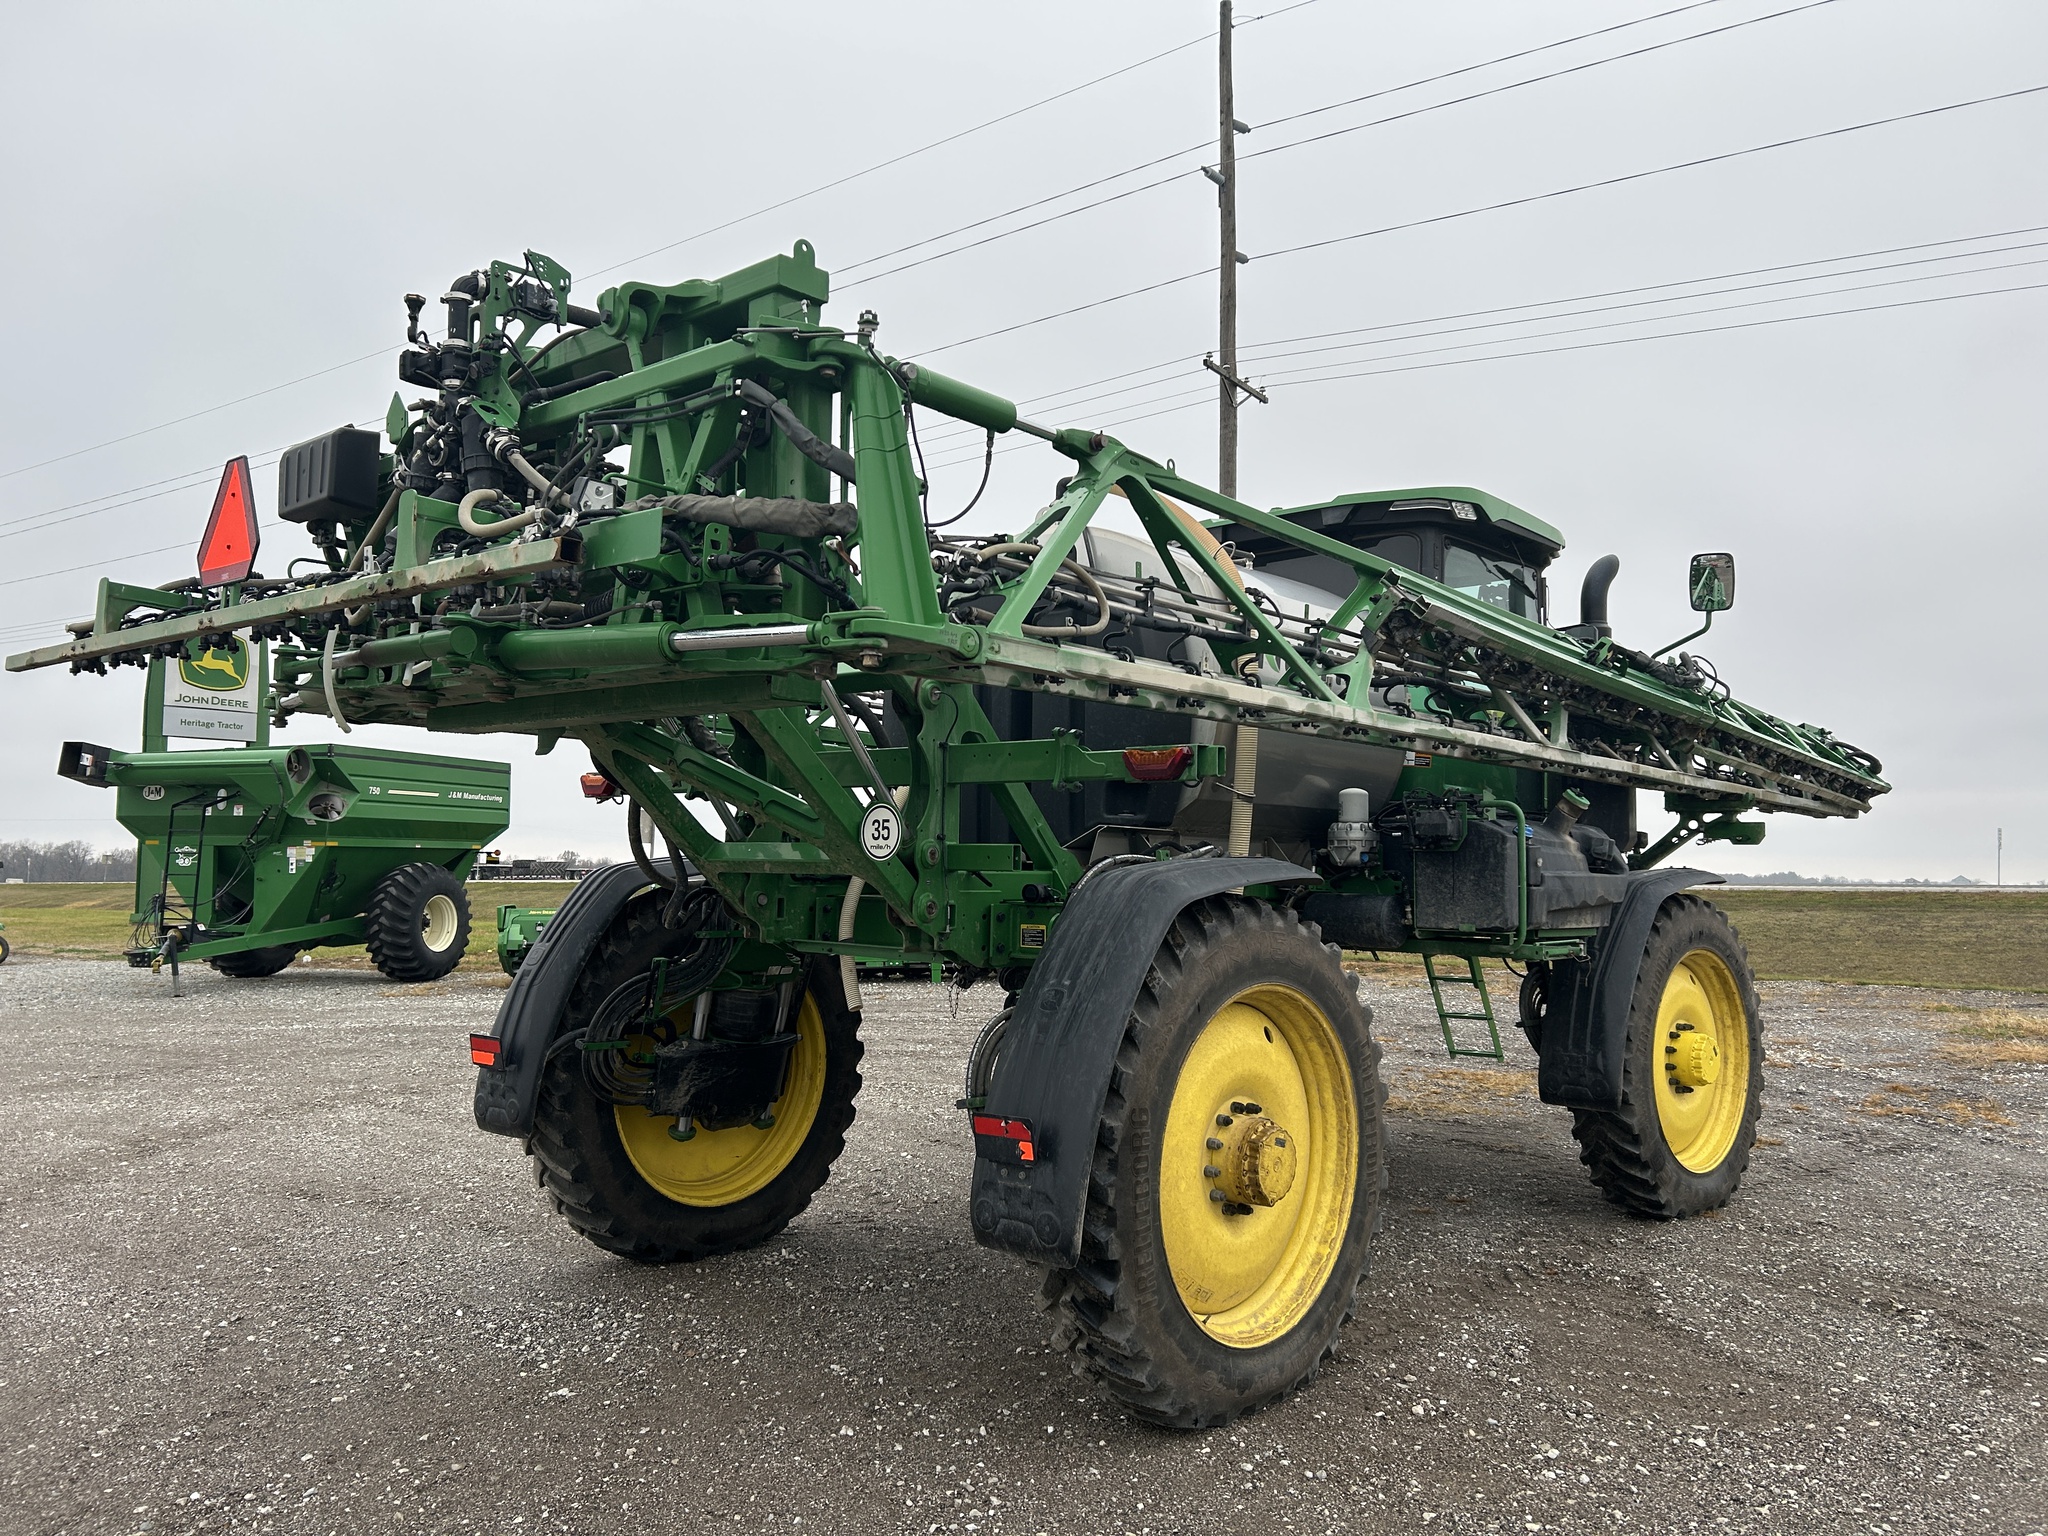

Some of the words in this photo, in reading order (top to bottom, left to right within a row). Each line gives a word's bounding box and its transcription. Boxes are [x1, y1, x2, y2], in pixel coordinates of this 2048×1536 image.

[174, 693, 209, 705] JOHN
[211, 696, 249, 709] DEERE
[180, 718, 215, 729] Heritage
[217, 720, 244, 731] Tractor
[144, 786, 162, 798] J&M
[368, 786, 381, 796] 750
[448, 791, 462, 800] J&M
[463, 792, 503, 804] Manufacturing
[871, 818, 890, 841] 35
[1360, 1034, 1380, 1208] TRELLEBORG
[1129, 1105, 1159, 1314] TRELLEBORG
